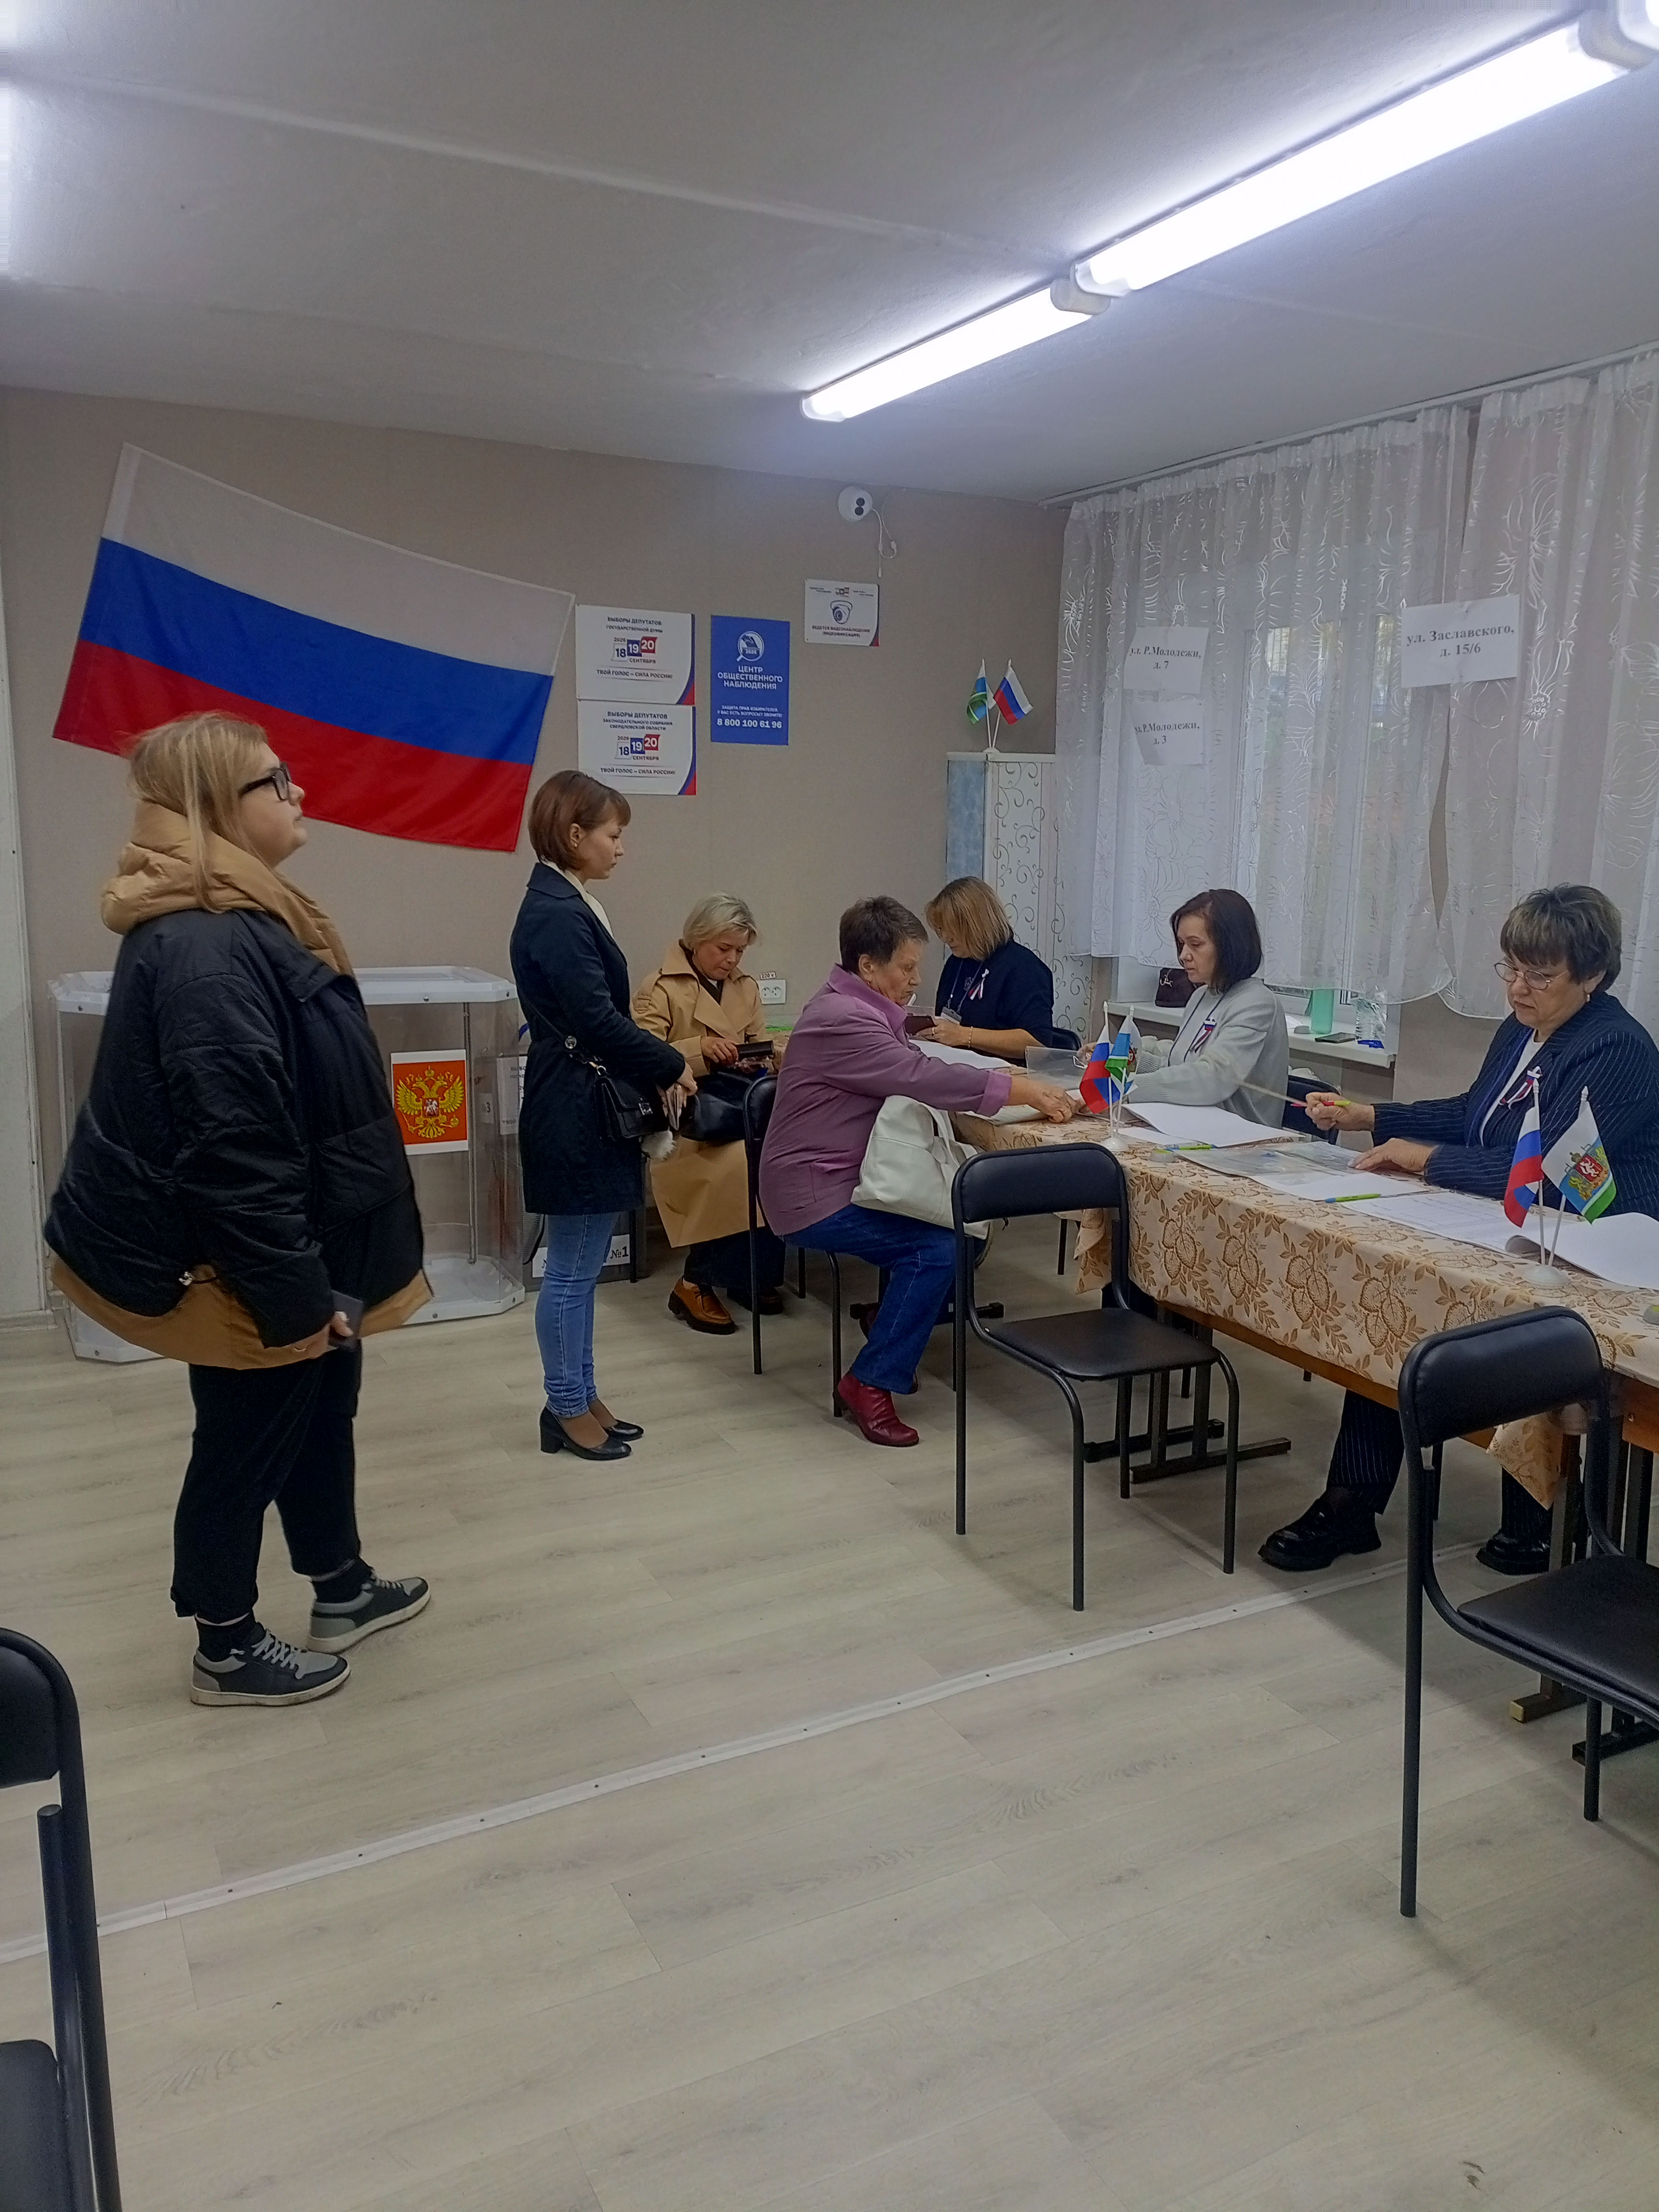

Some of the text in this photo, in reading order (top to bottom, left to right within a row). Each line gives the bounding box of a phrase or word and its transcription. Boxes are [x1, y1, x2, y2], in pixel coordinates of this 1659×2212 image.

[1407, 625, 1515, 646] ул. Заславского,
[615, 640, 654, 657] 18 19 20
[1130, 646, 1201, 659] ул. Р.Молодежи,
[1439, 642, 1481, 657] д. 15/6
[1164, 661, 1169, 669] 7
[717, 672, 783, 682] ОБЩЕСТВЕННОГО
[723, 680, 777, 690] НАБЛЮДЕНИЯ
[742, 719, 758, 727] 100
[1162, 735, 1167, 744] 3
[619, 737, 658, 756] 18 19 20
